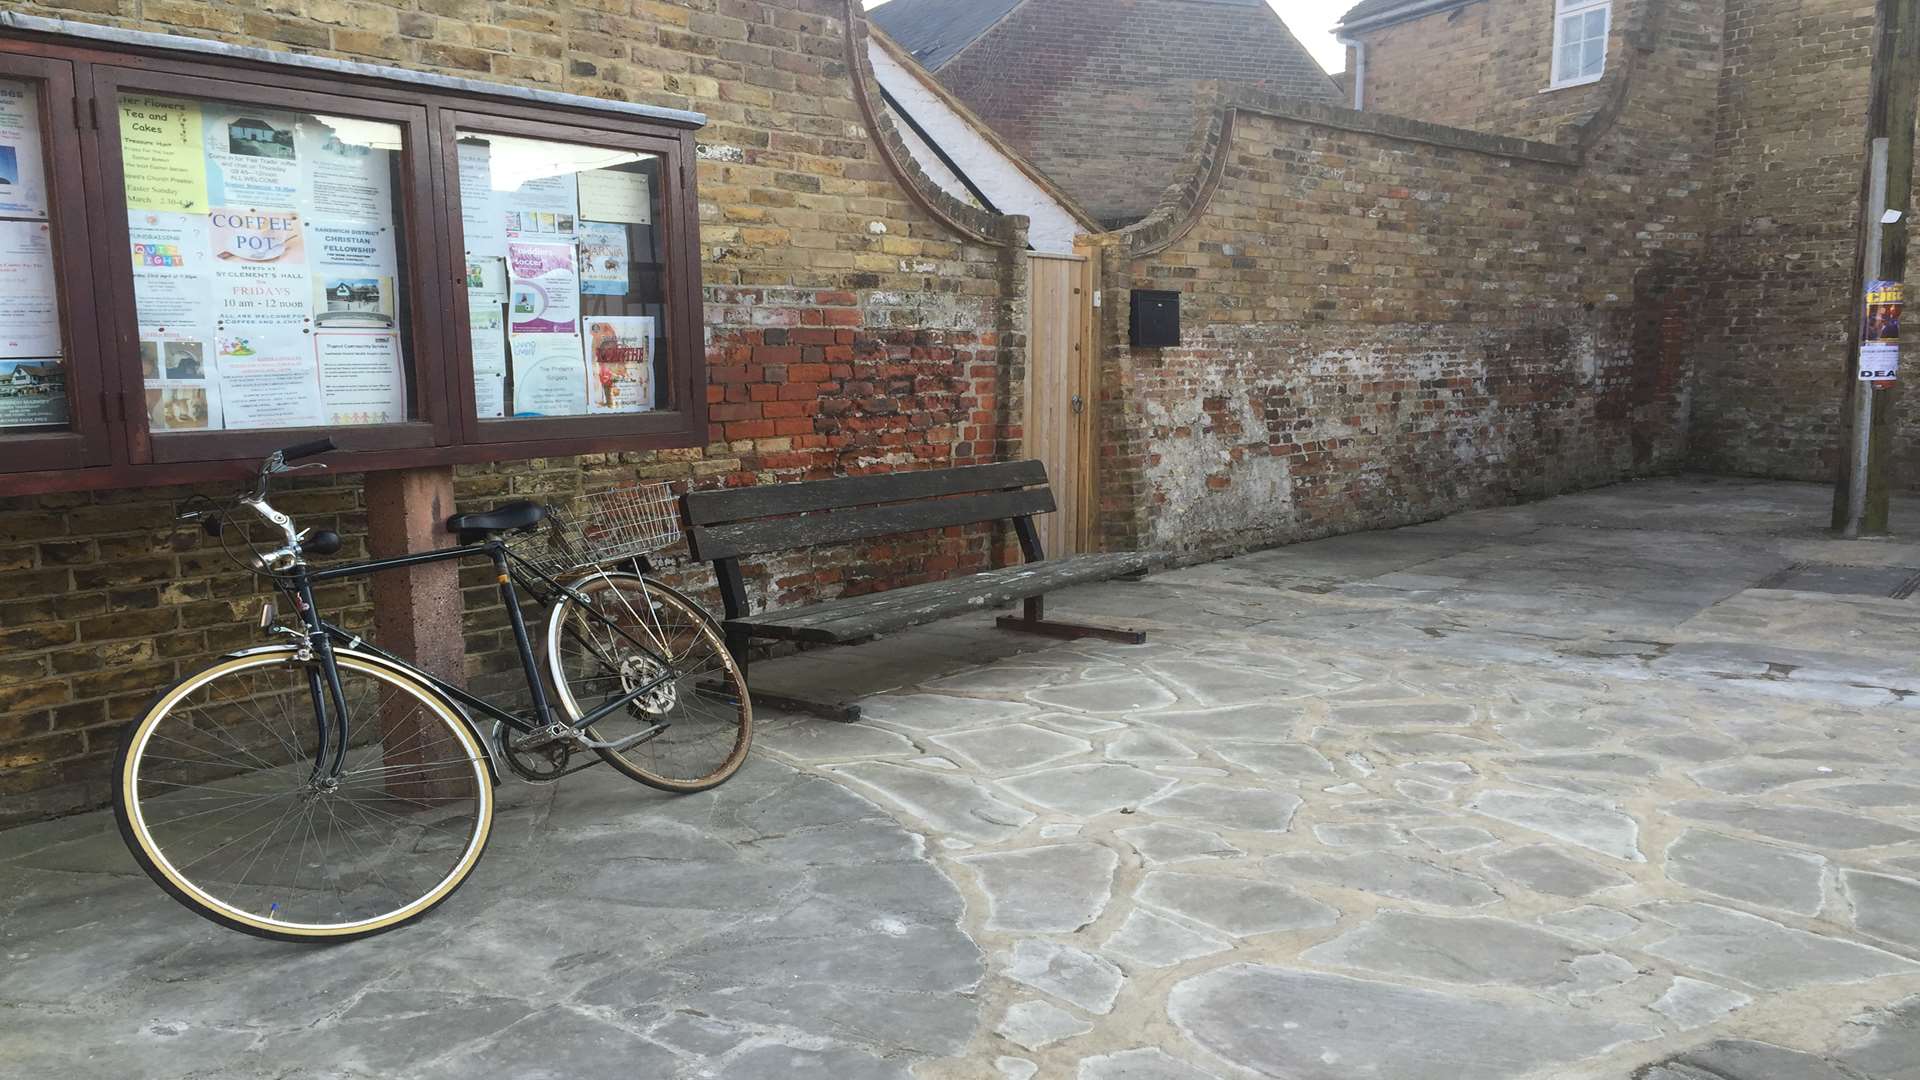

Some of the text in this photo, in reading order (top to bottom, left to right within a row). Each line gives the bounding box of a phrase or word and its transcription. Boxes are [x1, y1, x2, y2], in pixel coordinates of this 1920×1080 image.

[144, 98, 187, 111] Flowers
[123, 108, 168, 122] Tea and
[131, 122, 163, 134] Cakes
[212, 214, 293, 232] COFFEE
[236, 235, 275, 250] POT
[325, 235, 371, 245] CHRISTIAN
[323, 245, 377, 255] FELLOWSHIP
[232, 286, 291, 296] FRIDAYS
[223, 299, 236, 308] 10
[265, 299, 277, 308] 12
[1860, 369, 1897, 378] DEA
